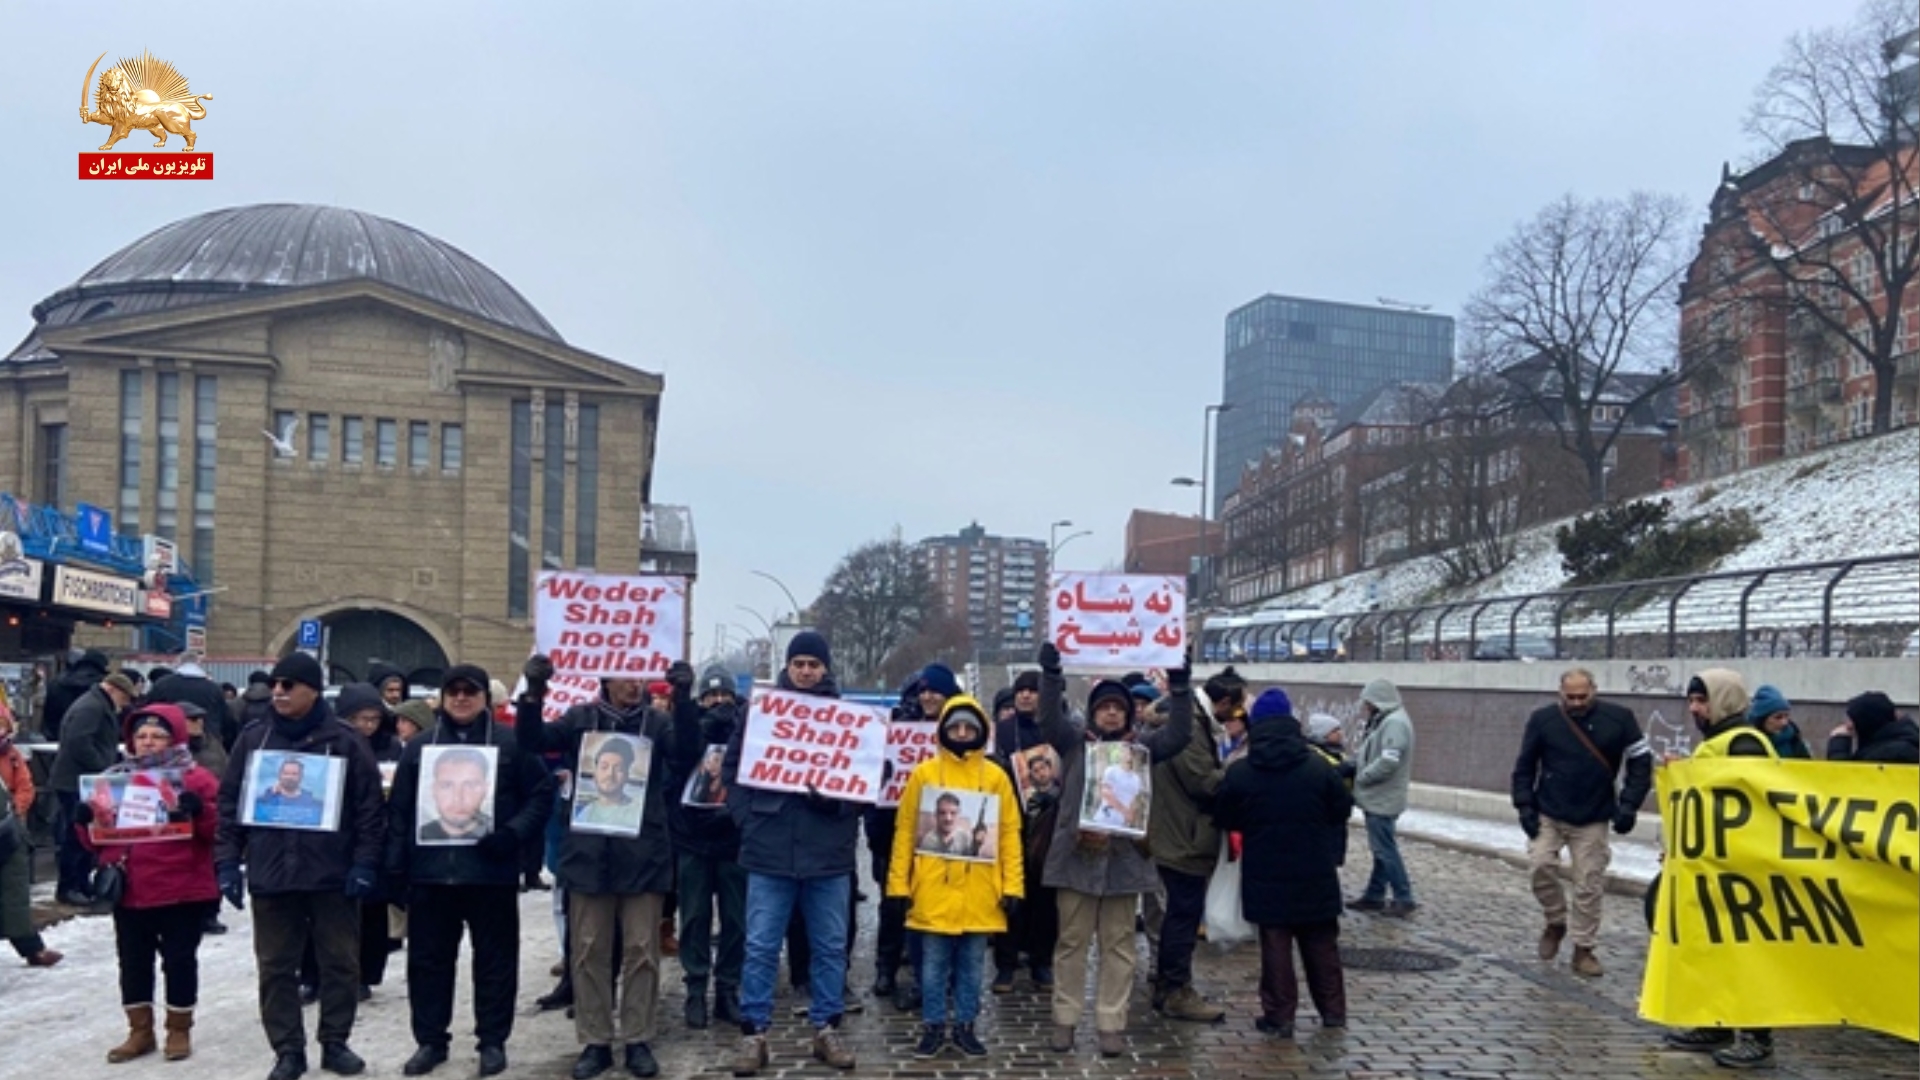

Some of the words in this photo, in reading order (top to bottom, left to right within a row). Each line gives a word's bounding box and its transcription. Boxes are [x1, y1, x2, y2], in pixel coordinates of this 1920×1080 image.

[548, 578, 666, 602] Weder
[1056, 581, 1134, 613] شاه
[1144, 584, 1172, 614] نه
[564, 603, 656, 625] Shah
[302, 624, 316, 642] P
[559, 629, 650, 648] noch
[1056, 616, 1143, 655] شیخ
[1153, 617, 1181, 647] نه
[549, 649, 671, 672] Mullah
[760, 694, 873, 728] Weder
[772, 720, 860, 749] Shah
[765, 745, 853, 770] noch
[750, 761, 868, 795] Mullah
[1695, 872, 1865, 947] IRAN
